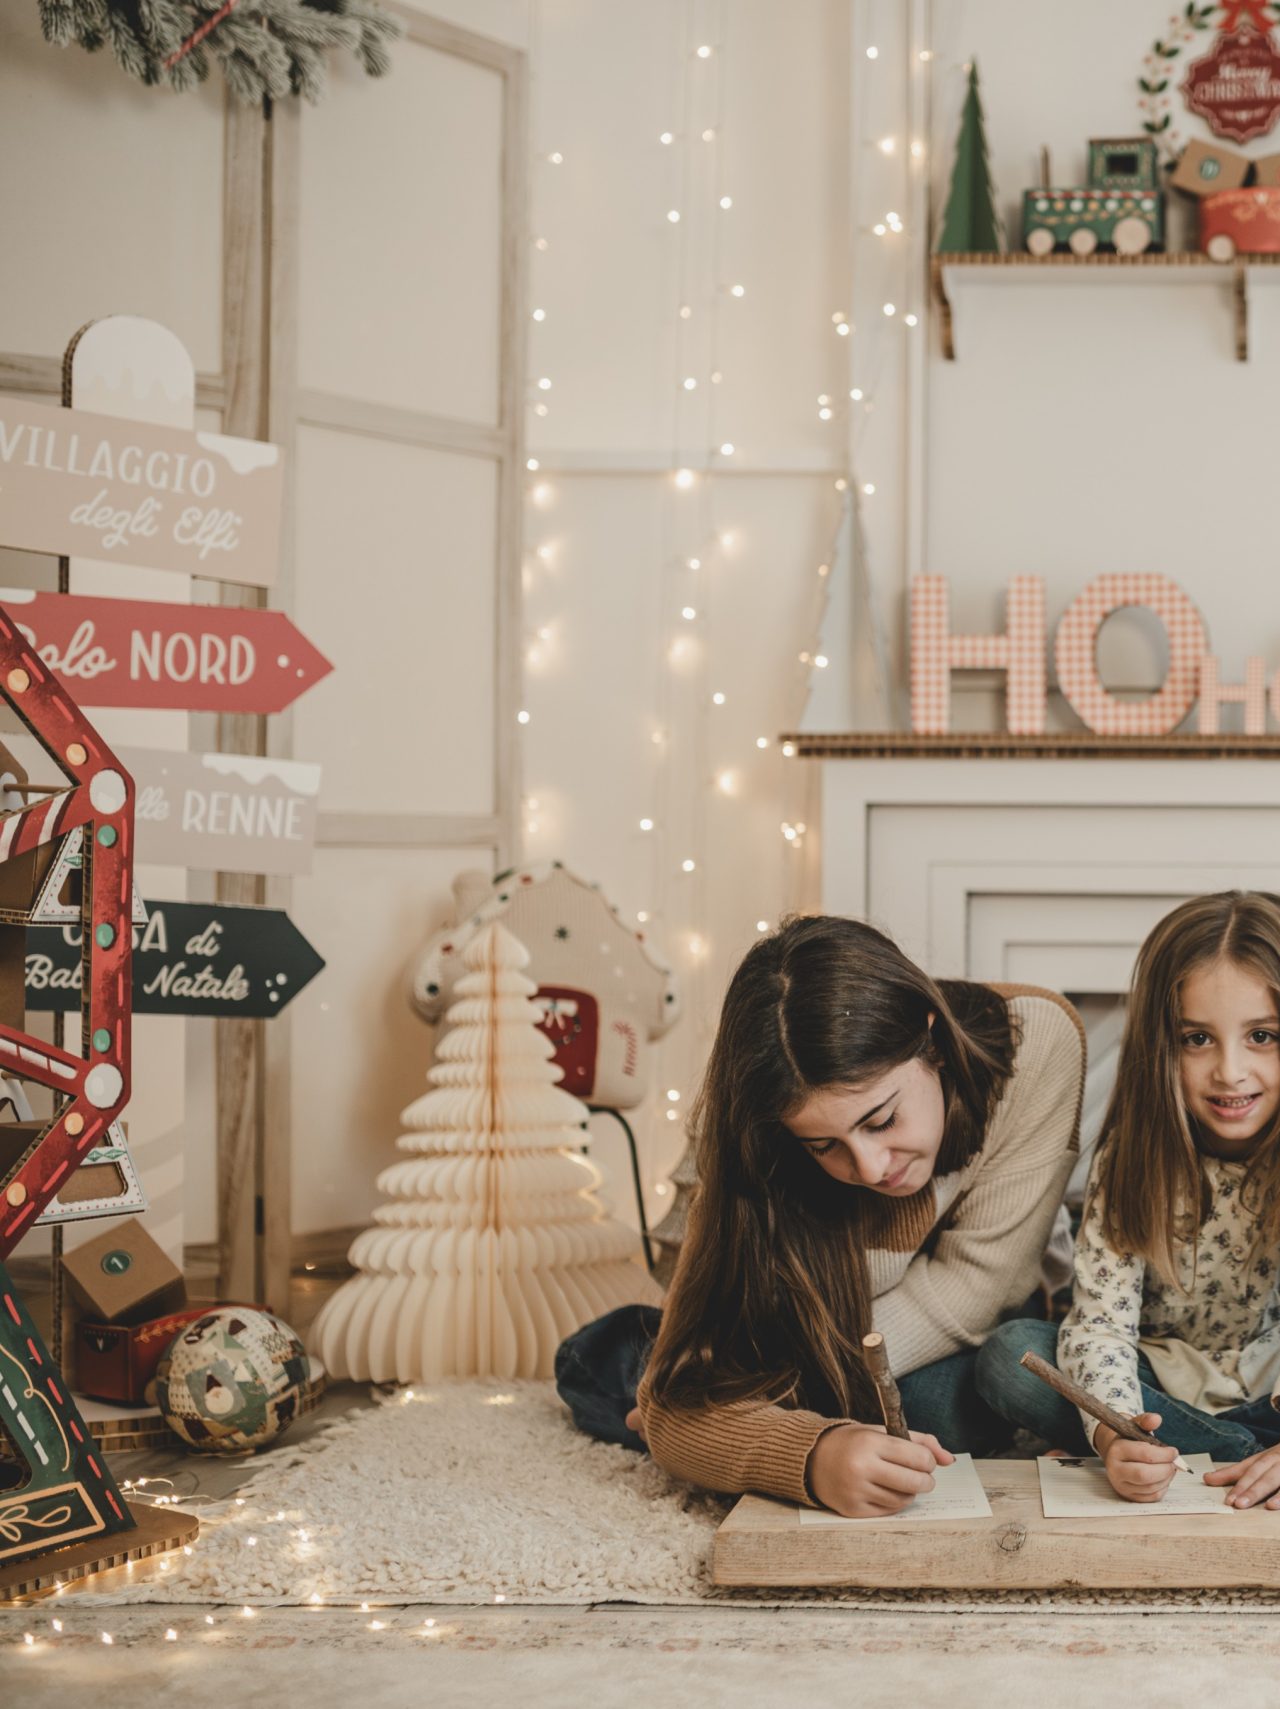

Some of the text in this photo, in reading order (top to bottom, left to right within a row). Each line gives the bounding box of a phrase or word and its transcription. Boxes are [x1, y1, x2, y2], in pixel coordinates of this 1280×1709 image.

[0, 420, 216, 498] VILLAGGIO
[69, 488, 242, 560] degli Elfi
[129, 630, 256, 686] NORD
[182, 789, 305, 841] RENNE
[185, 920, 223, 957] di
[143, 961, 250, 1001] Natale
